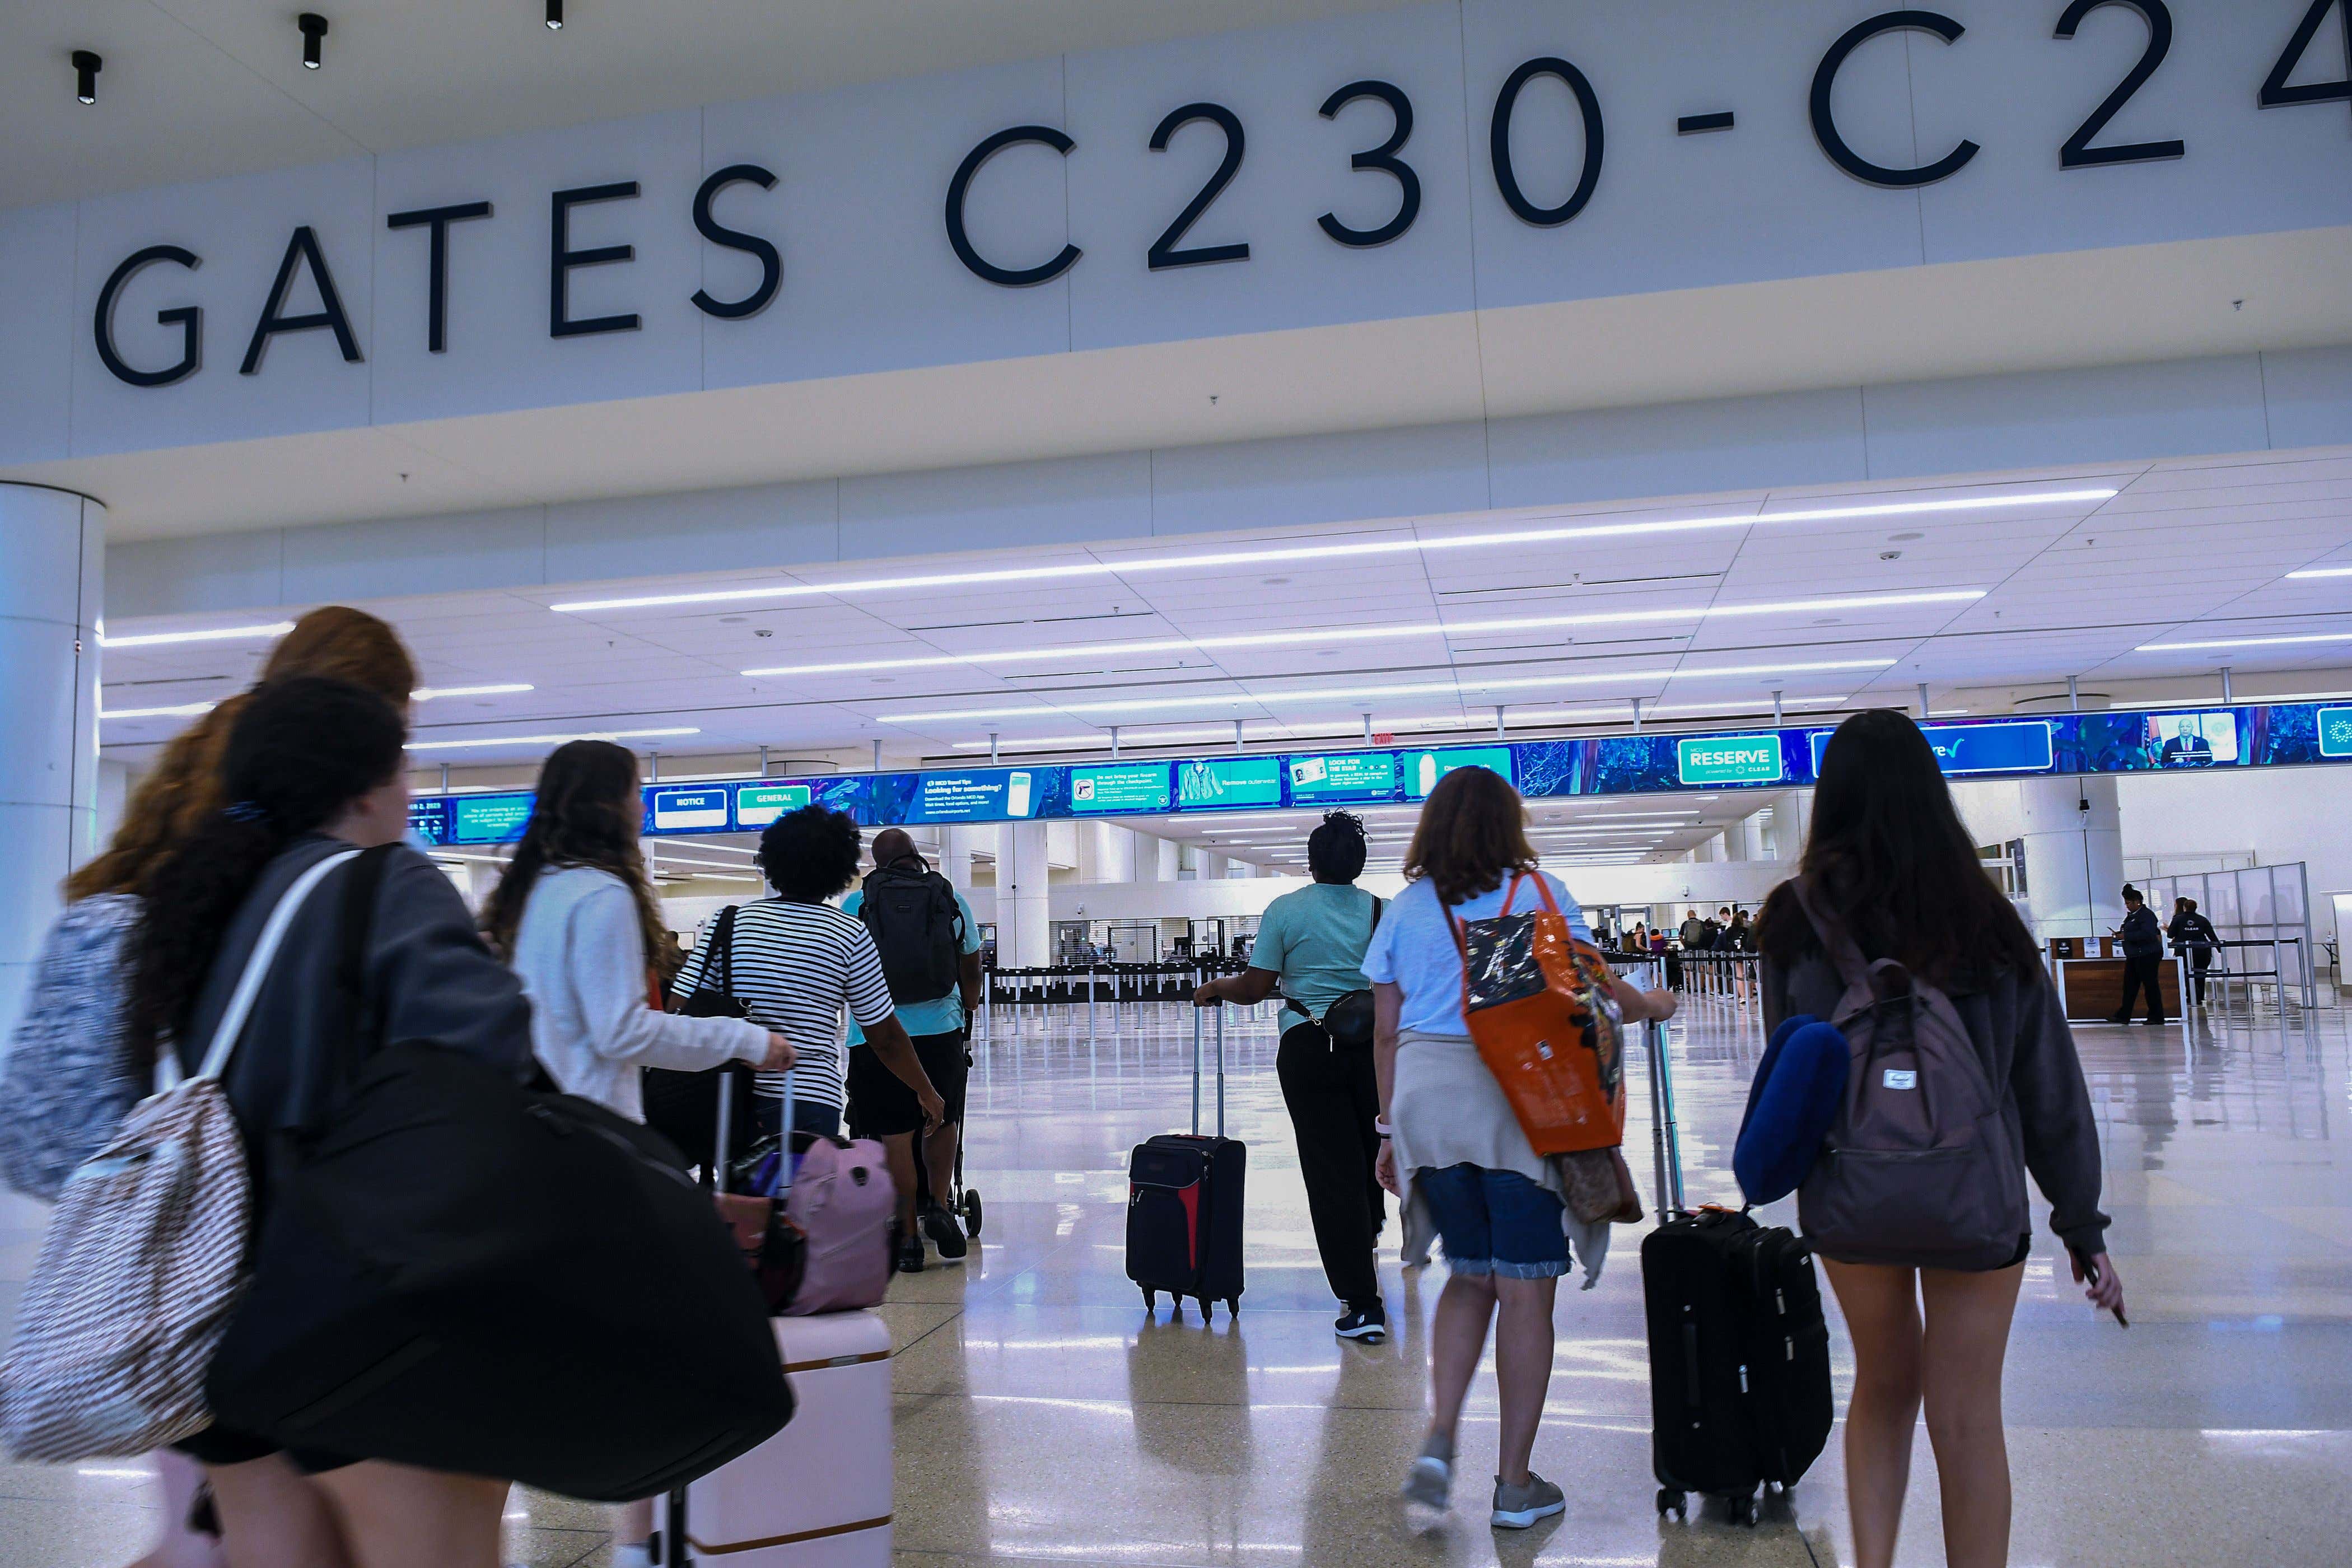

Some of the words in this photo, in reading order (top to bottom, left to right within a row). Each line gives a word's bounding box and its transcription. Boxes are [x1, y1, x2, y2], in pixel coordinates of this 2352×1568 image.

[94, 164, 785, 388] GATES
[1932, 746, 1946, 756] re
[1690, 749, 1770, 766] RESERVE
[676, 797, 705, 806] NOTICE
[757, 794, 792, 802] GENERAL
